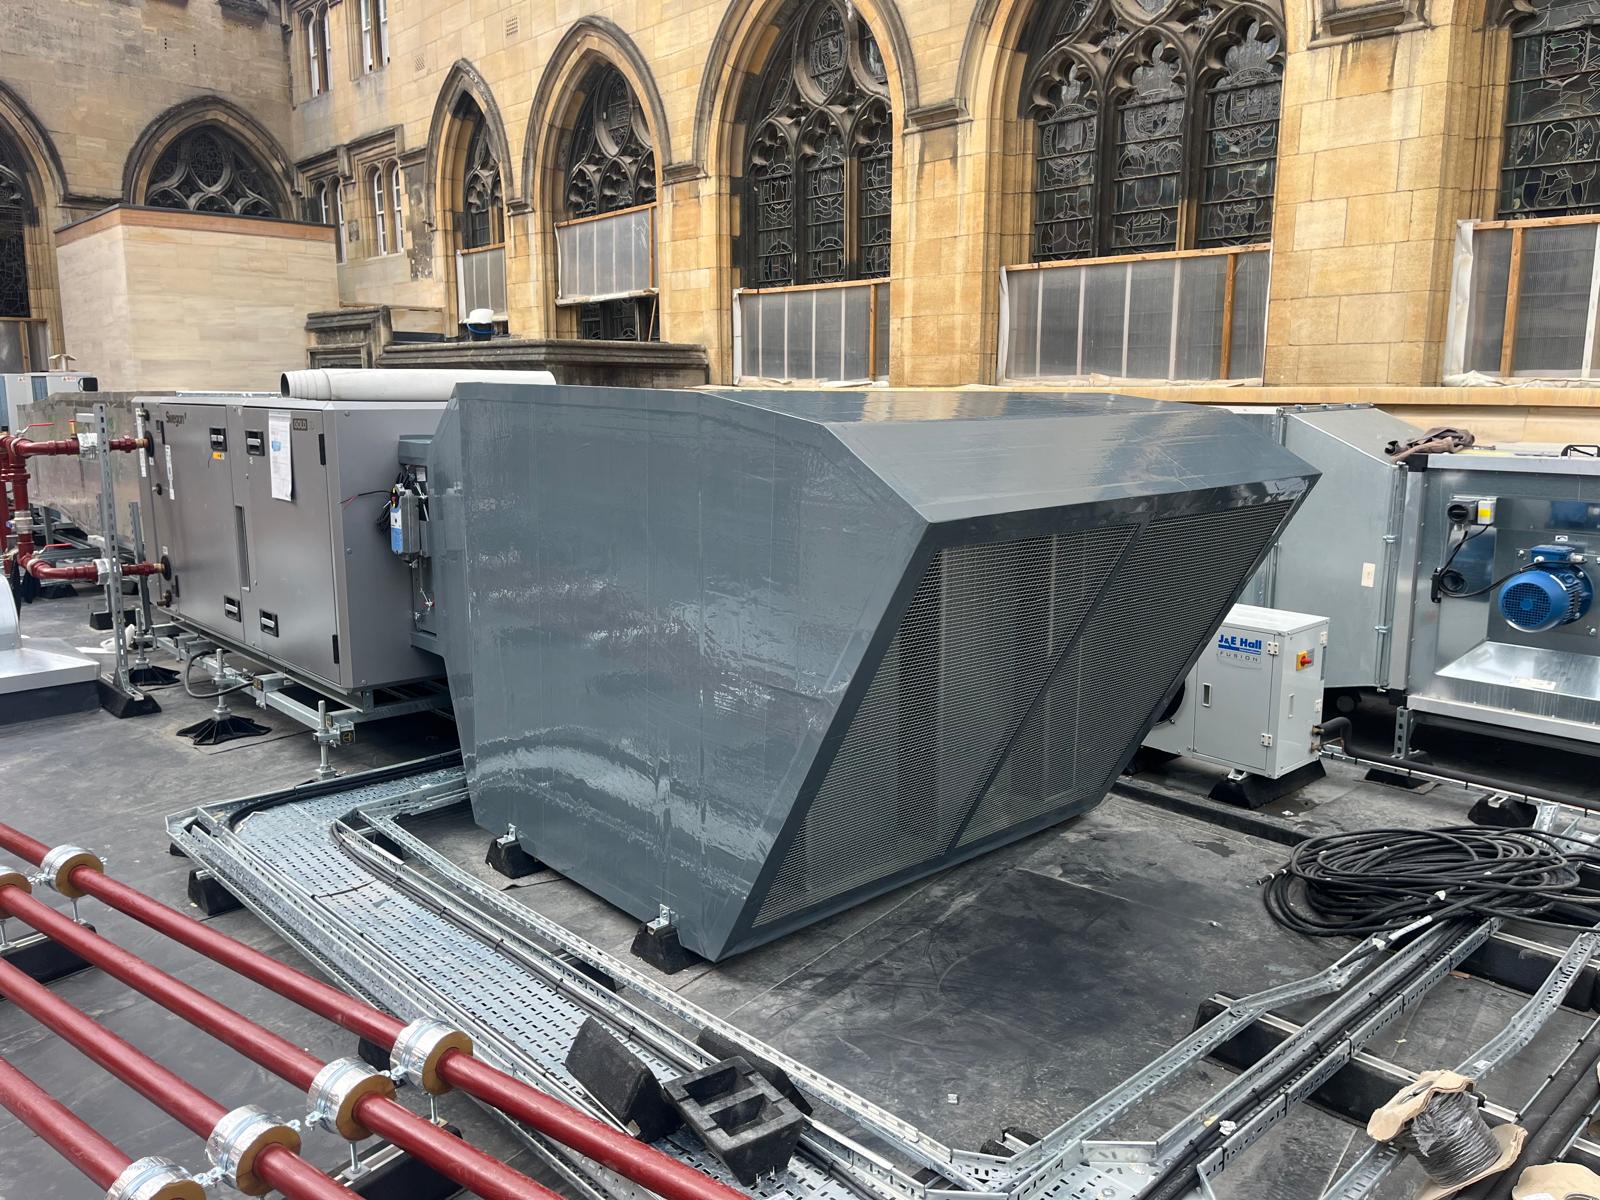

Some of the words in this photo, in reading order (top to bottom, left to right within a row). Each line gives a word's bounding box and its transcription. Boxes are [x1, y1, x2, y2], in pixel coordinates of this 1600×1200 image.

[165, 411, 185, 427] Swegon
[294, 419, 307, 430] GOLD
[1218, 634, 1237, 646] J&E
[1240, 637, 1262, 650] Hall
[1219, 650, 1258, 662] FUSION
